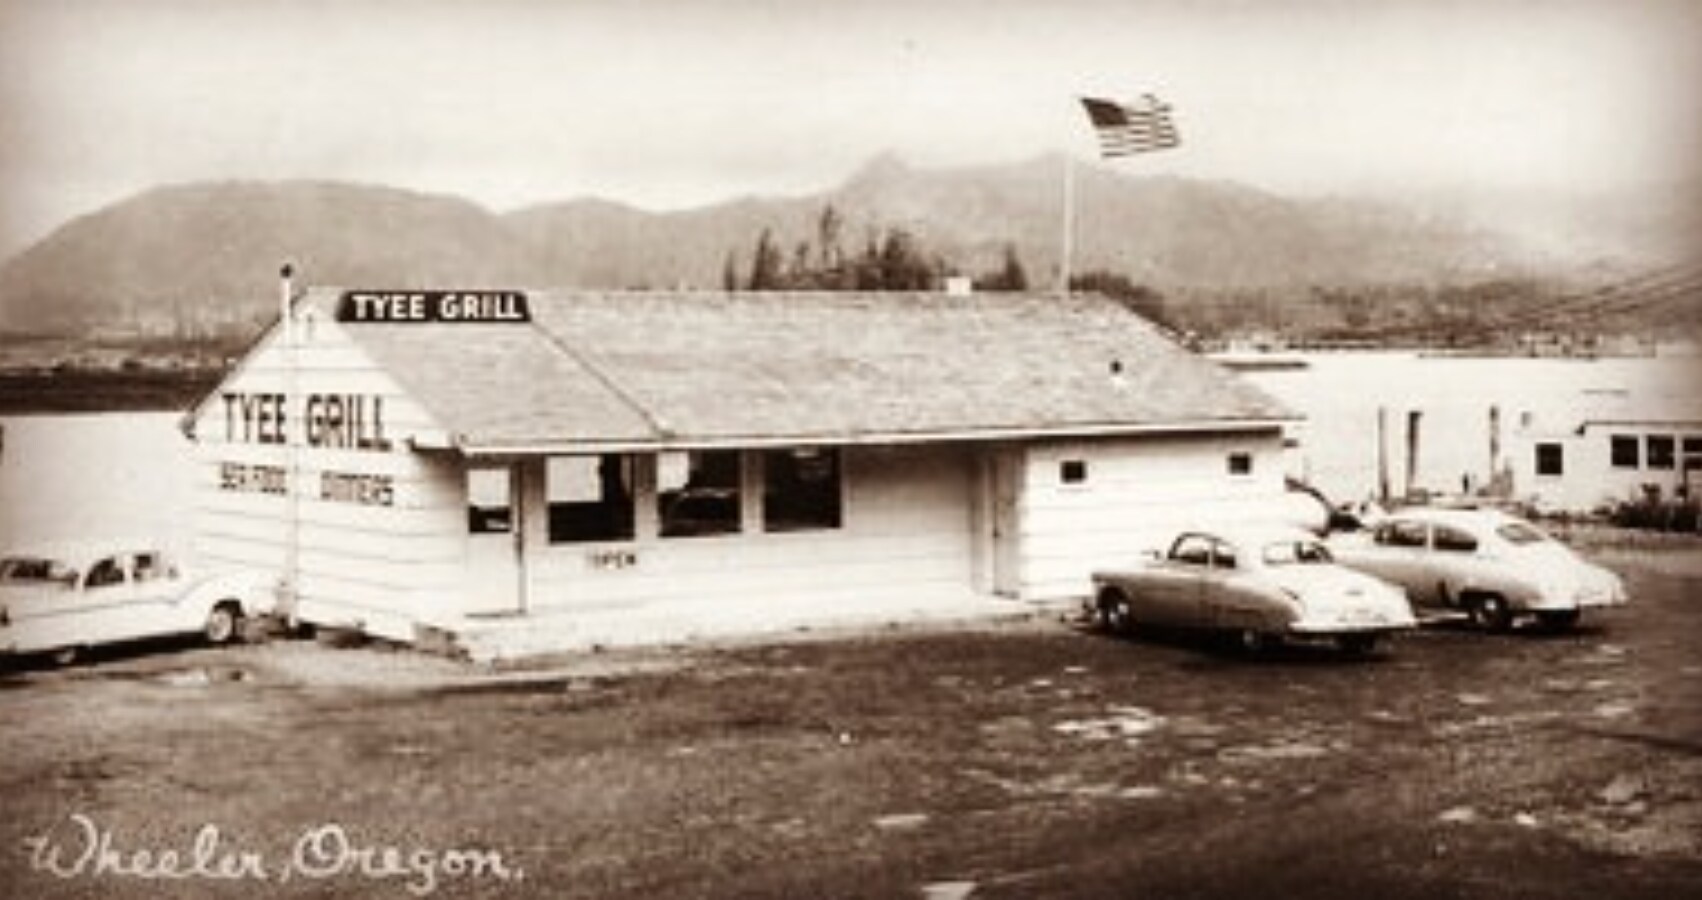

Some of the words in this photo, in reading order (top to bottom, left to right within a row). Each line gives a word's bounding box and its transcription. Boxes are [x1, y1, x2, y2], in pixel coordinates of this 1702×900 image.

[352, 294, 425, 319] TYEE
[440, 294, 523, 319] GRILL
[222, 393, 286, 444] TYEE
[307, 393, 392, 452] GRILL
